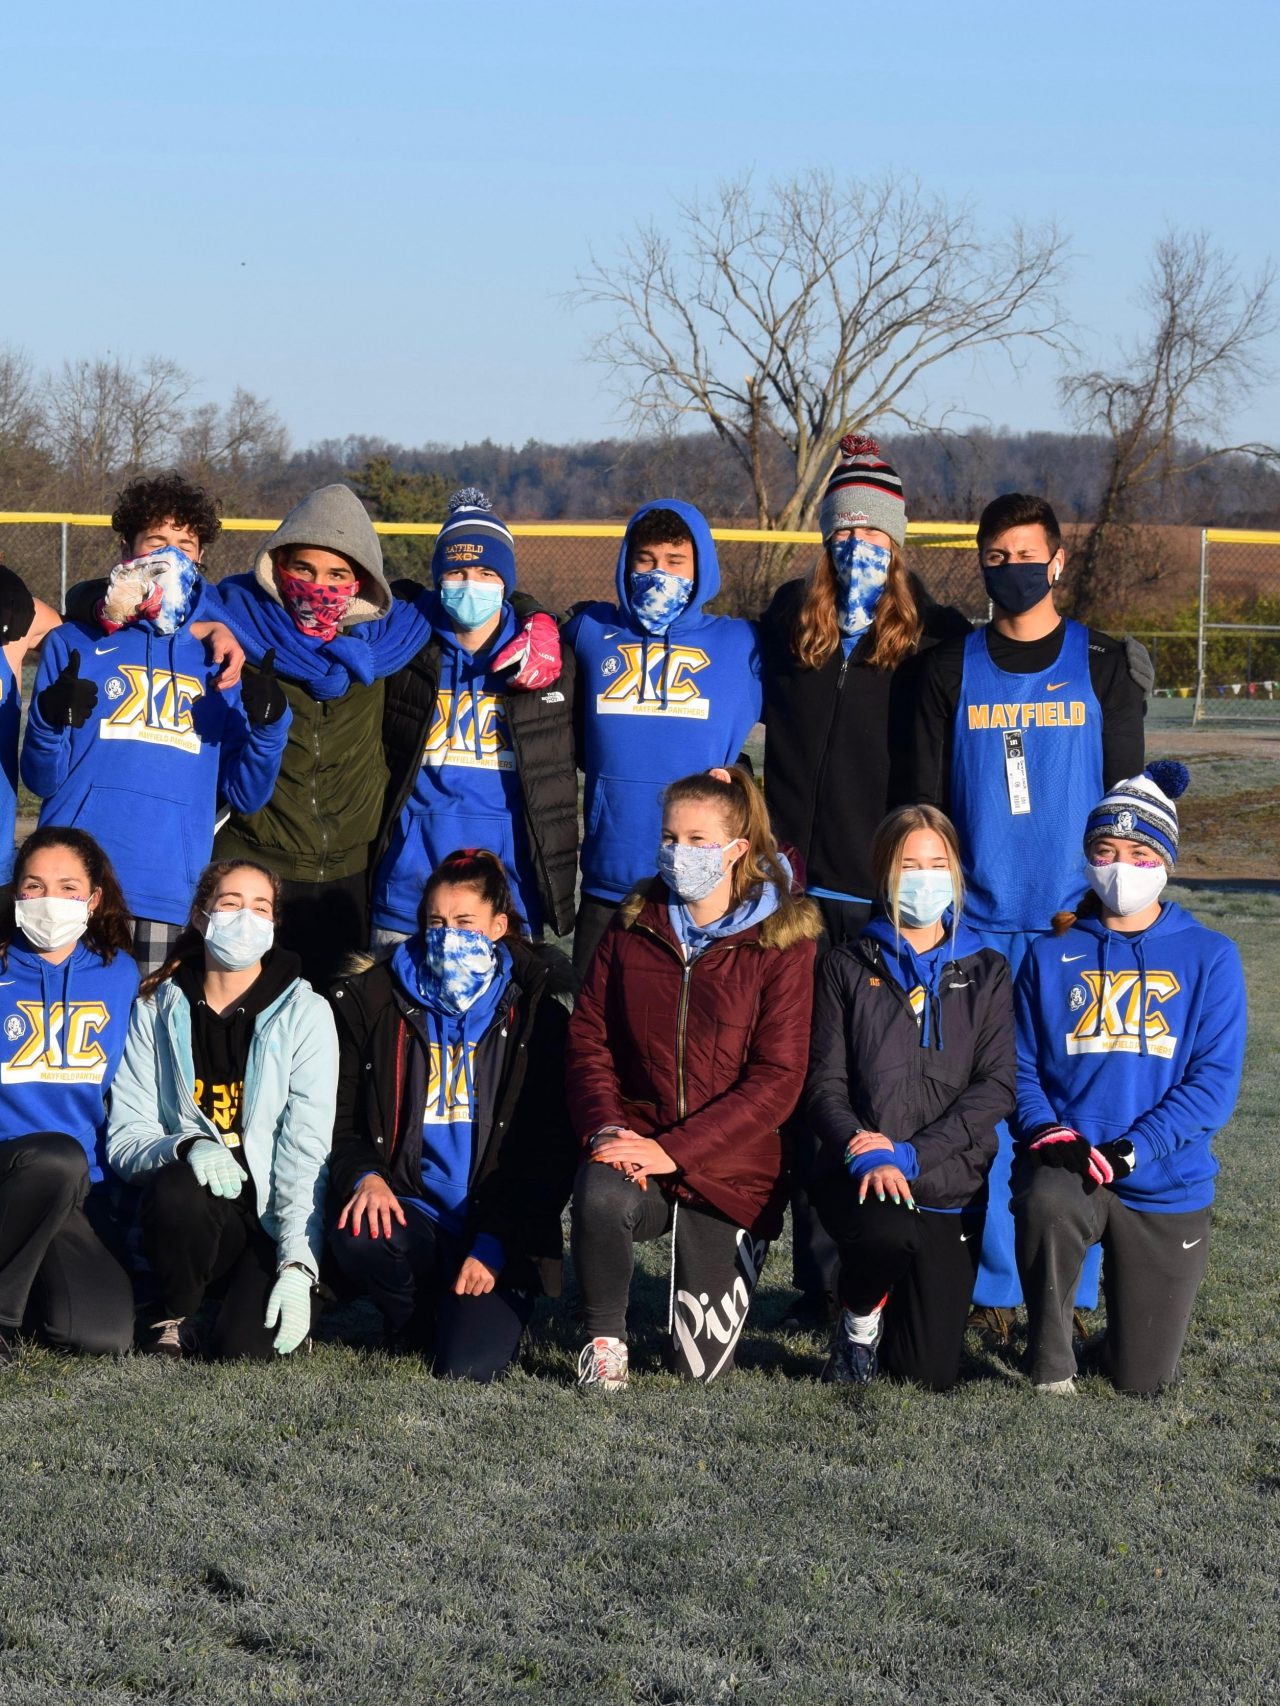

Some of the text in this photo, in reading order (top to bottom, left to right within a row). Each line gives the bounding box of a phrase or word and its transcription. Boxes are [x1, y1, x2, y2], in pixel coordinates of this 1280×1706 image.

[106, 664, 206, 736] XC
[601, 643, 711, 704] XC
[668, 705, 705, 716] PANTHERS
[967, 701, 1086, 730] MAYFIELD
[6, 1000, 111, 1071] XC
[1071, 970, 1181, 1041] XC
